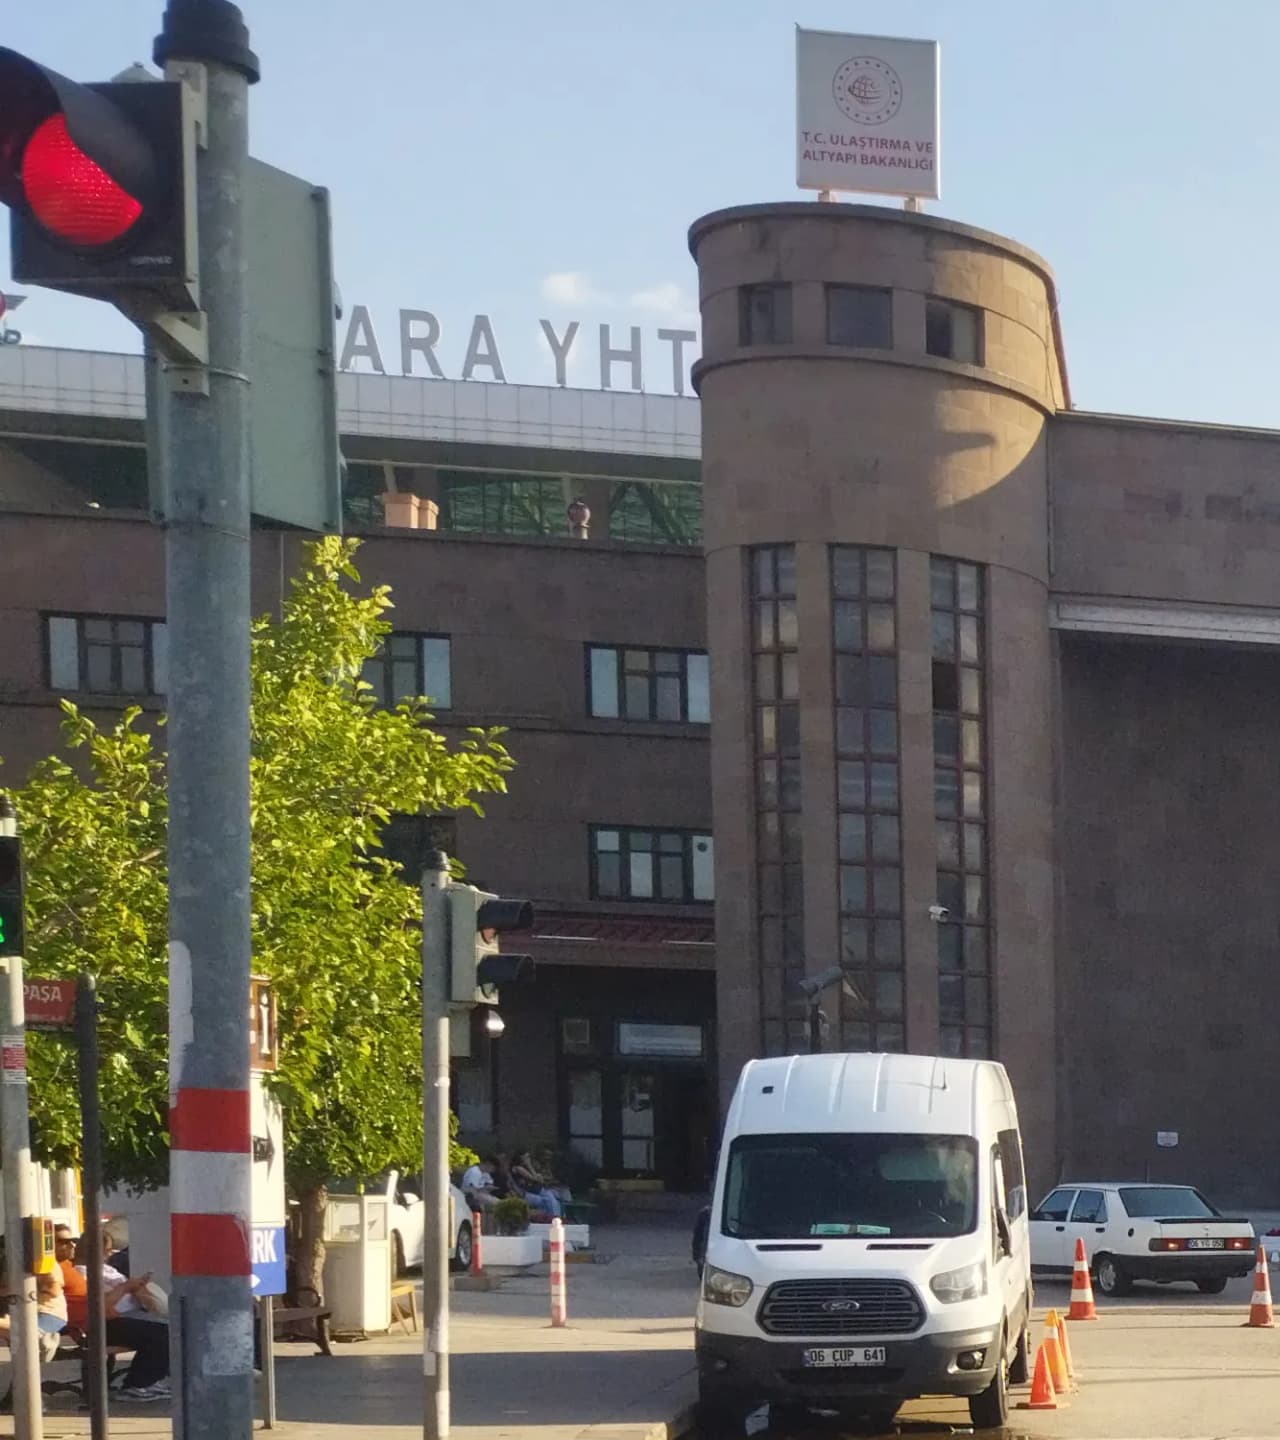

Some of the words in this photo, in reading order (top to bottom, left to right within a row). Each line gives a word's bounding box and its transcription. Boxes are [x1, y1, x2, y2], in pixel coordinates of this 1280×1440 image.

[802, 131, 827, 145] T.C.
[830, 133, 911, 151] ULAŞTIRMA
[915, 141, 934, 154] VE
[802, 149, 858, 164] ALTYAPI
[860, 154, 934, 171] BAKANLIĞI
[339, 304, 508, 384] ARA
[538, 318, 698, 397] YHT
[251, 1229, 278, 1265] RK
[810, 1349, 825, 1362] 06
[832, 1348, 854, 1362] CUP
[863, 1348, 884, 1361] 641
